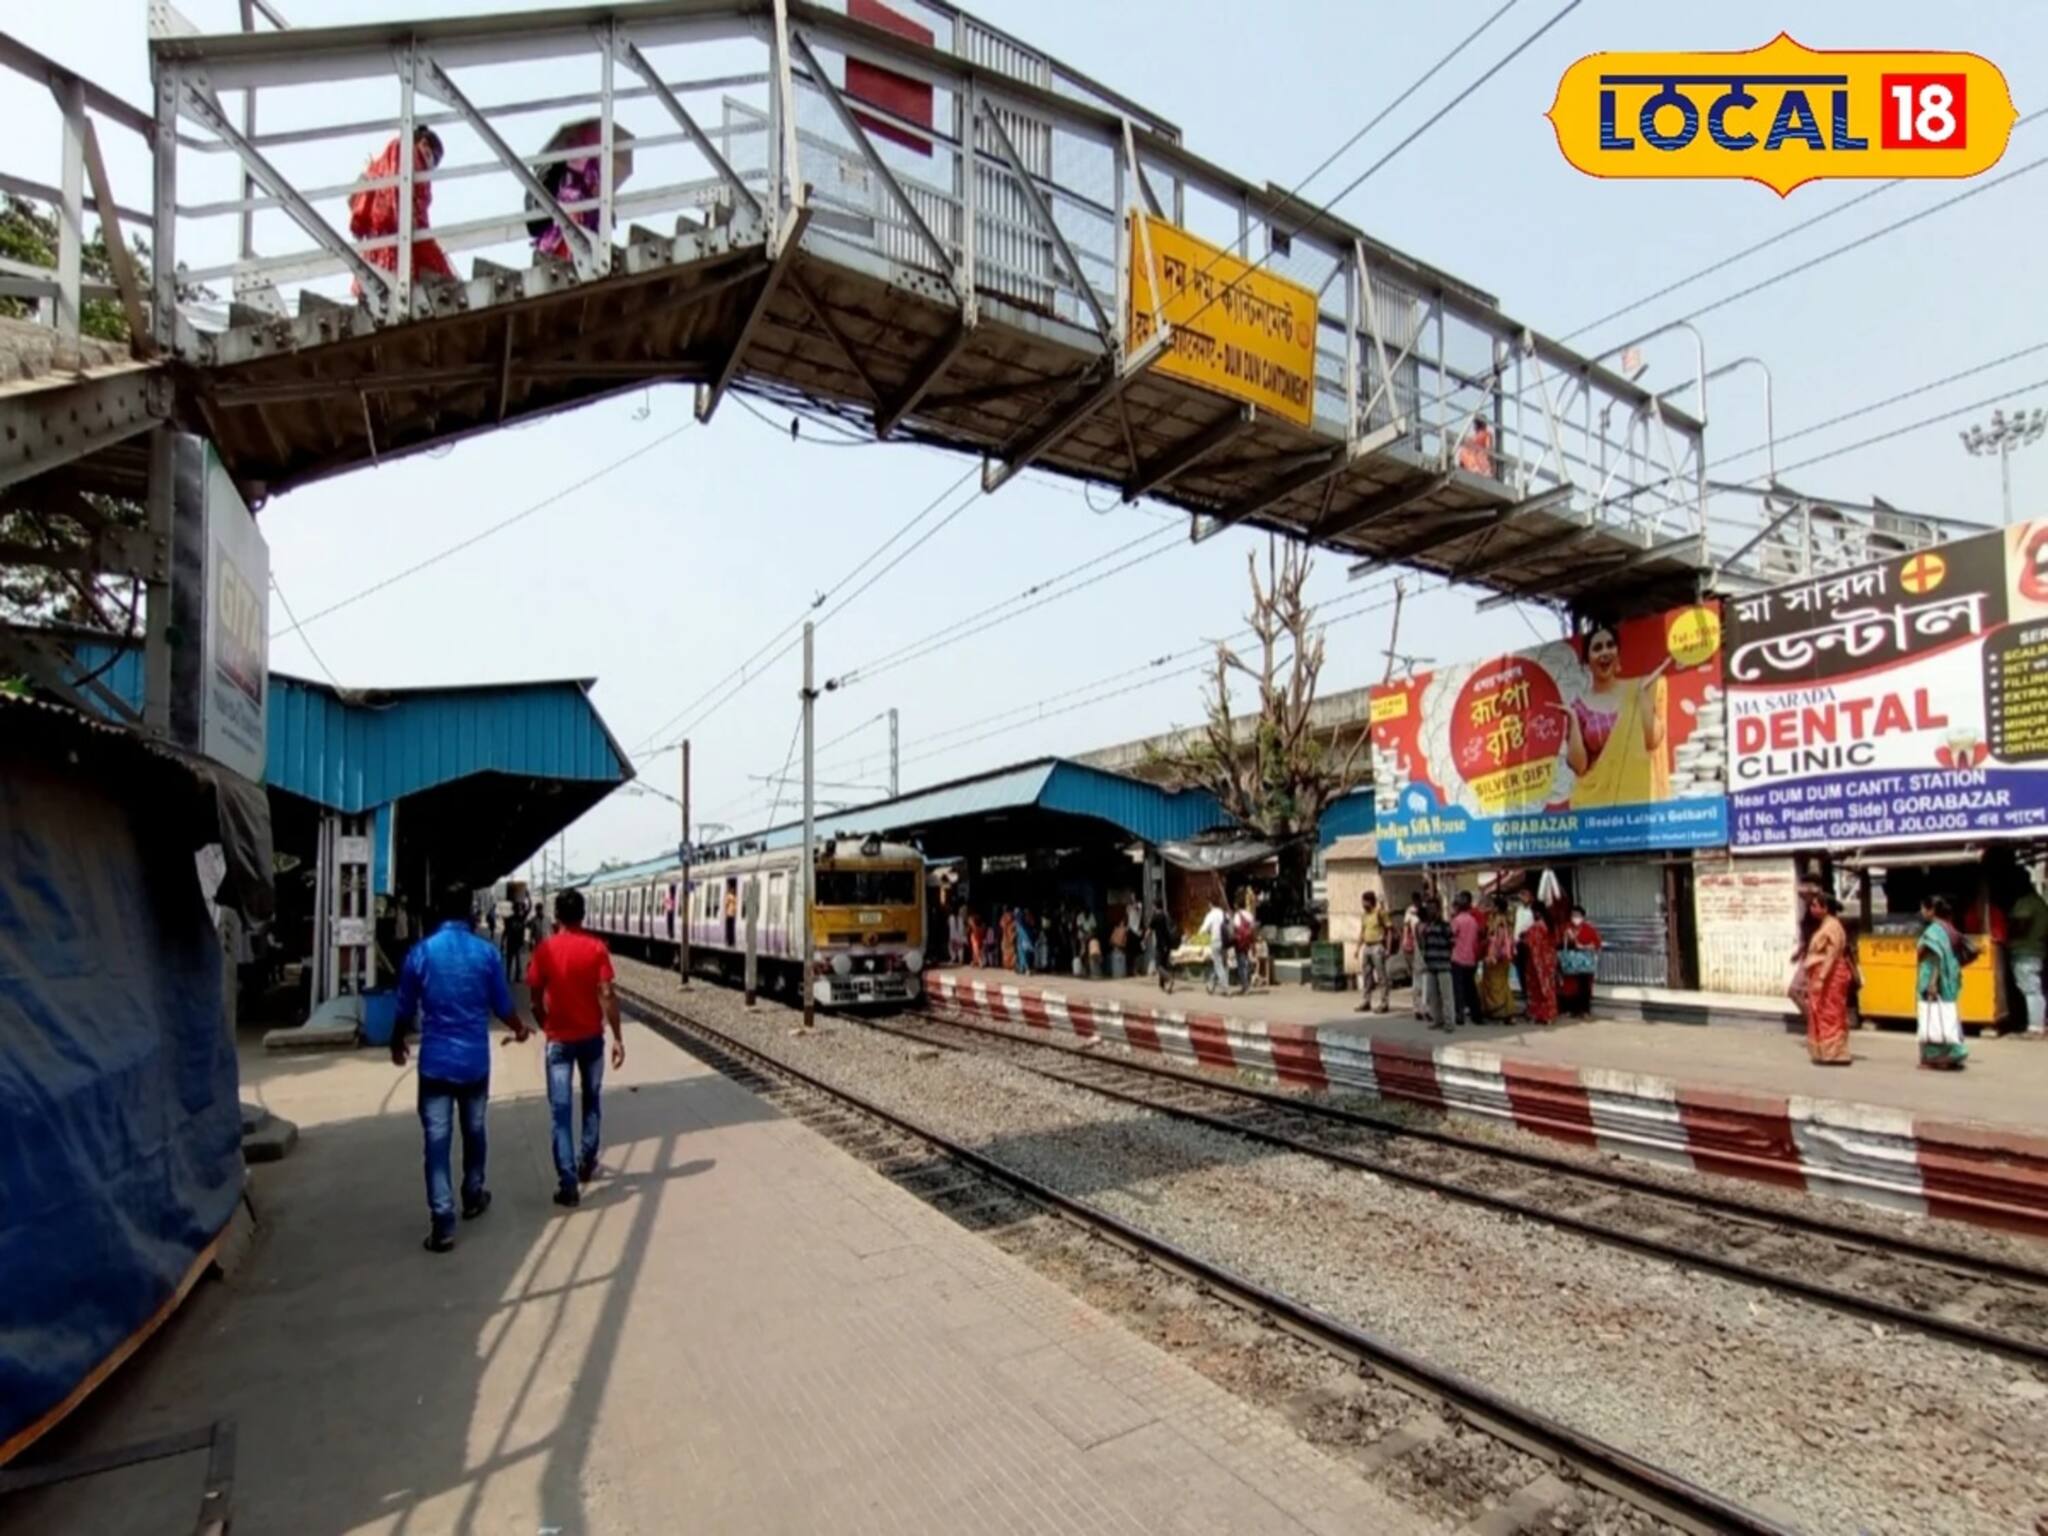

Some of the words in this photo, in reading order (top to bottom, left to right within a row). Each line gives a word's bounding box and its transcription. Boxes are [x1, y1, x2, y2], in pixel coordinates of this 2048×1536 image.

[1225, 343, 1242, 376] DUM
[1734, 592, 1771, 624] মা
[1780, 565, 1888, 612] সারদা
[1730, 591, 1989, 681] ডেন্টাল
[1734, 700, 1762, 718] MA
[1766, 687, 1837, 712] SARADA
[1737, 688, 1949, 756] DENTAL
[1737, 742, 1876, 779] CLINIC
[1475, 773, 1519, 798] SILVER
[1522, 762, 1553, 784] GIFT
[1734, 794, 1765, 809] Near
[1769, 788, 1803, 806] DUM
[1807, 783, 1842, 801] DUM
[1846, 777, 1905, 798] CANTT.
[1909, 769, 1987, 792] STATION
[1755, 811, 1778, 826] No.
[1781, 805, 1844, 824] Platform
[1847, 800, 1888, 820] Side)
[1892, 789, 2011, 815] GORABAZAR
[1492, 816, 1579, 837] GORABAZAR
[1763, 828, 1787, 842] Bus
[1829, 818, 1895, 837] GOPALER
[1898, 812, 1968, 832] JOLOJOG
